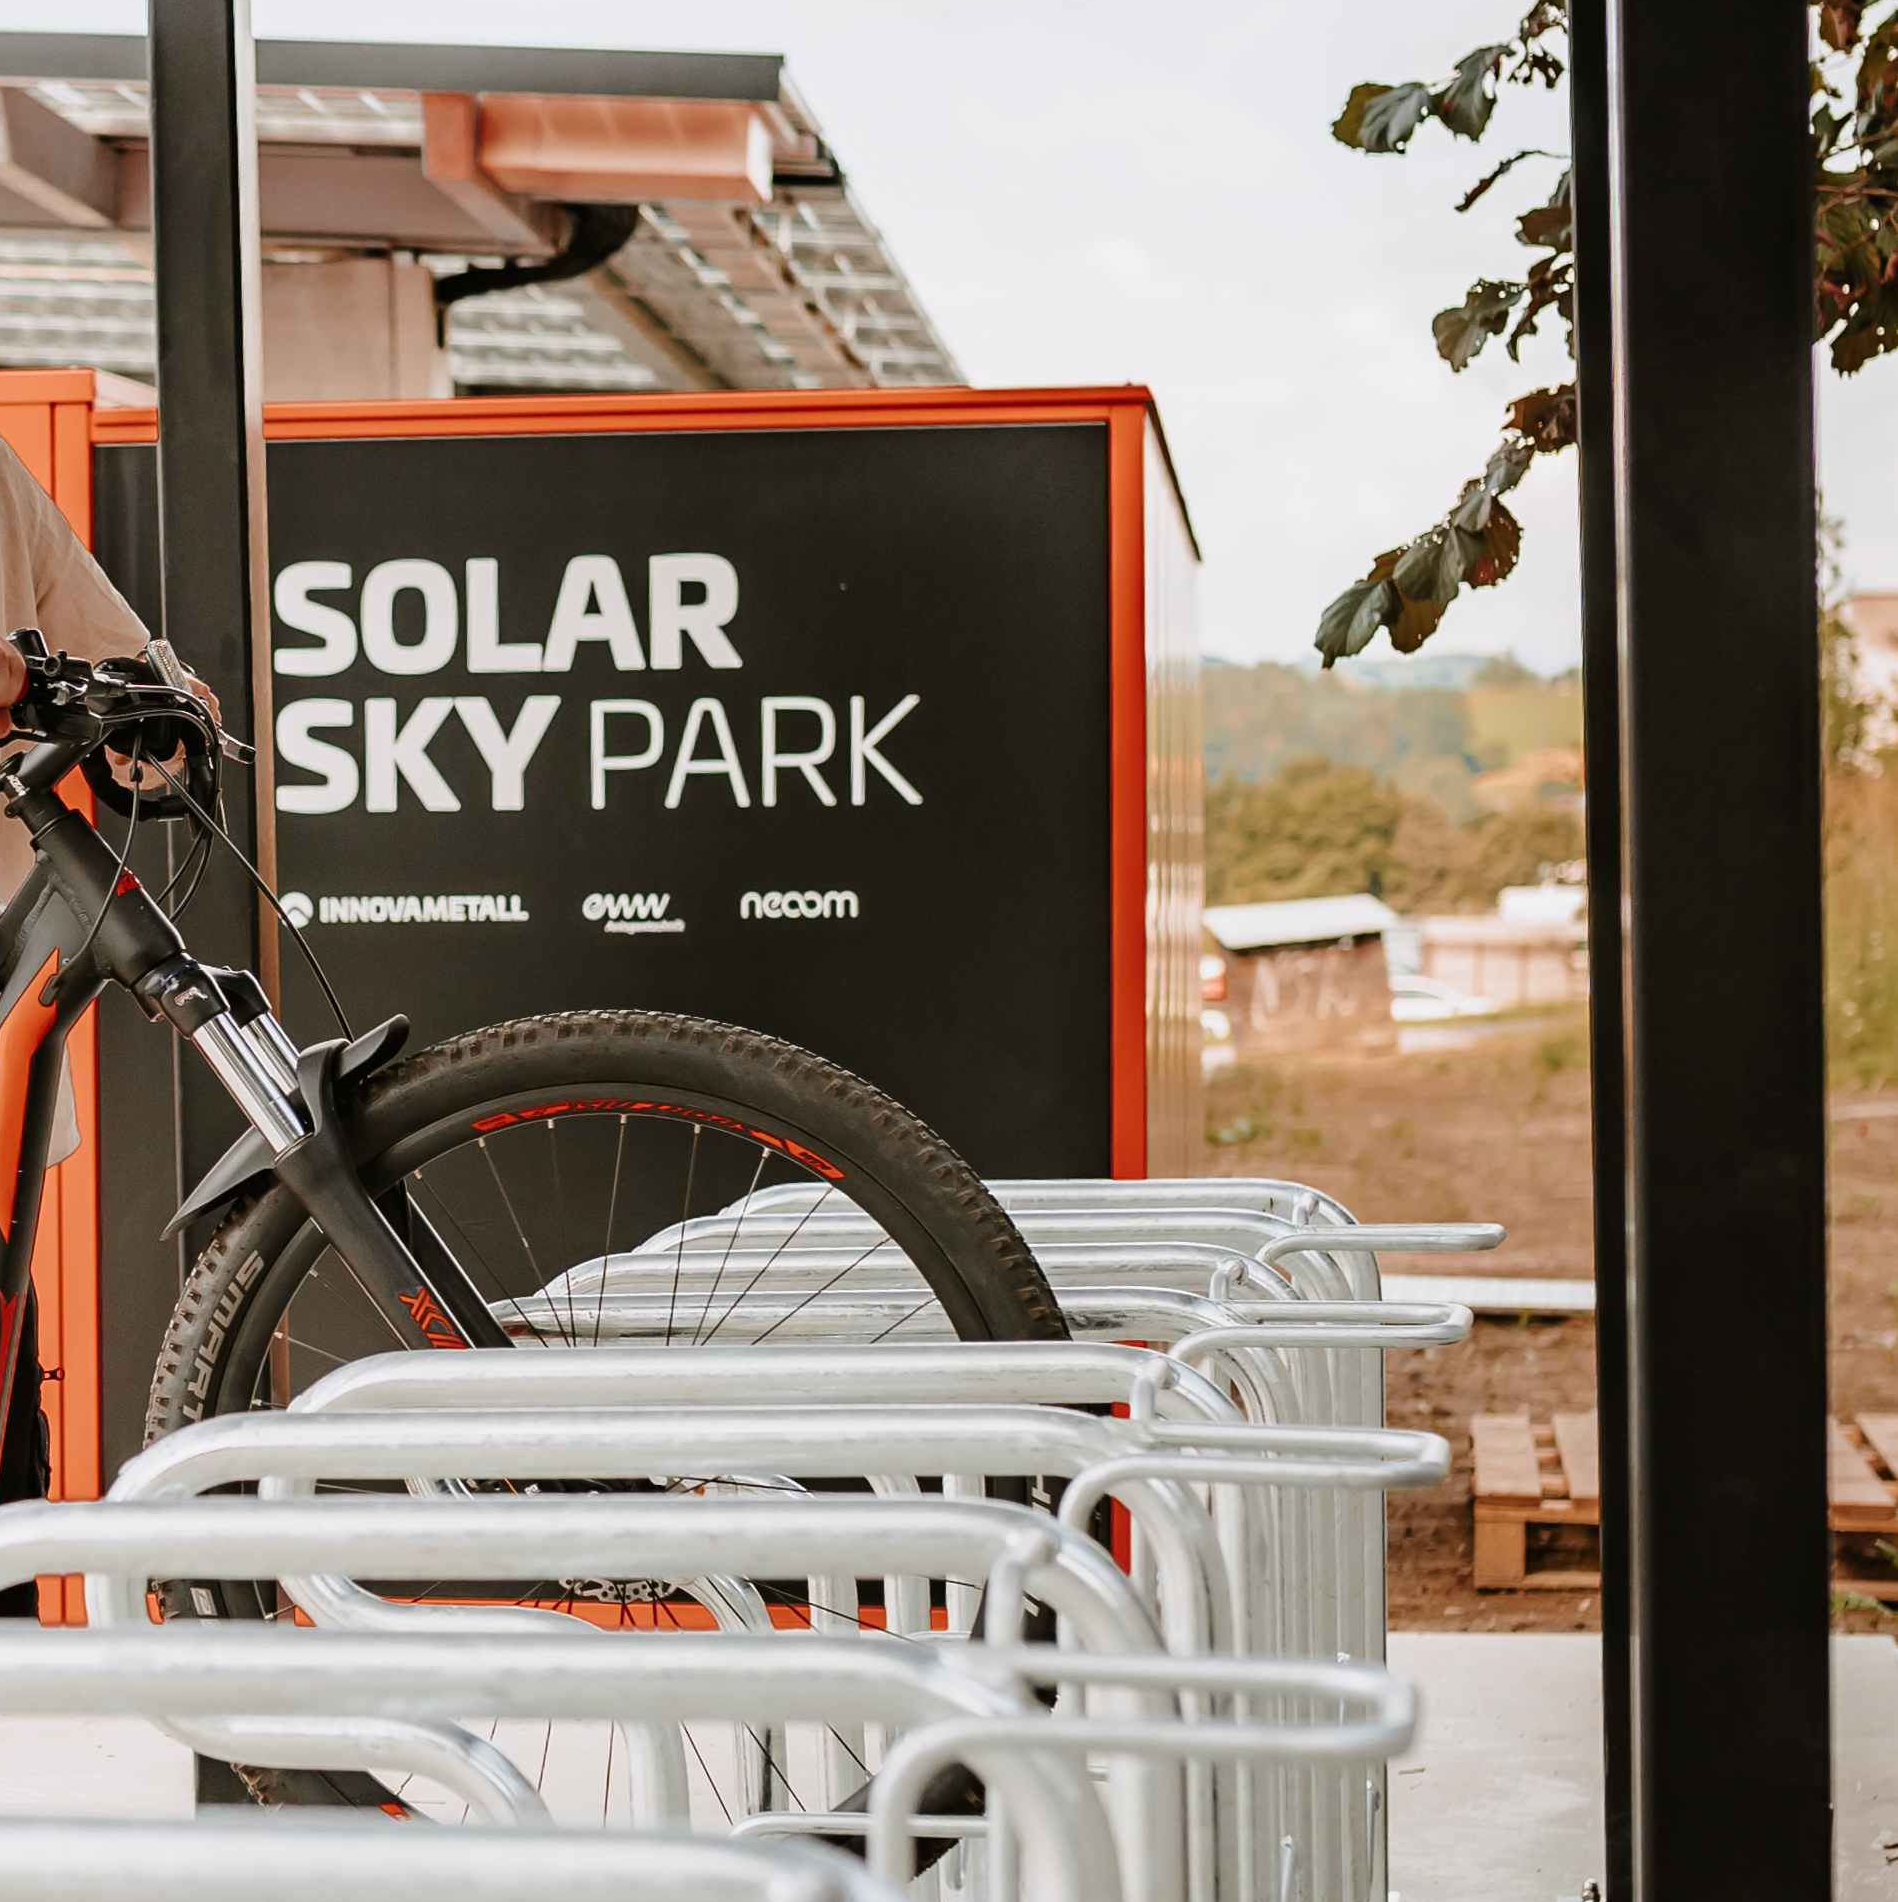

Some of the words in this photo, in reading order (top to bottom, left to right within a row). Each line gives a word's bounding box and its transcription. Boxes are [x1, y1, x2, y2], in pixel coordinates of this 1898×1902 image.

[274, 553, 743, 677] SOLAR
[275, 695, 562, 814] SKY
[590, 694, 923, 809] PARK
[319, 895, 530, 924] INNOVAMETALL
[740, 891, 860, 919] neoom
